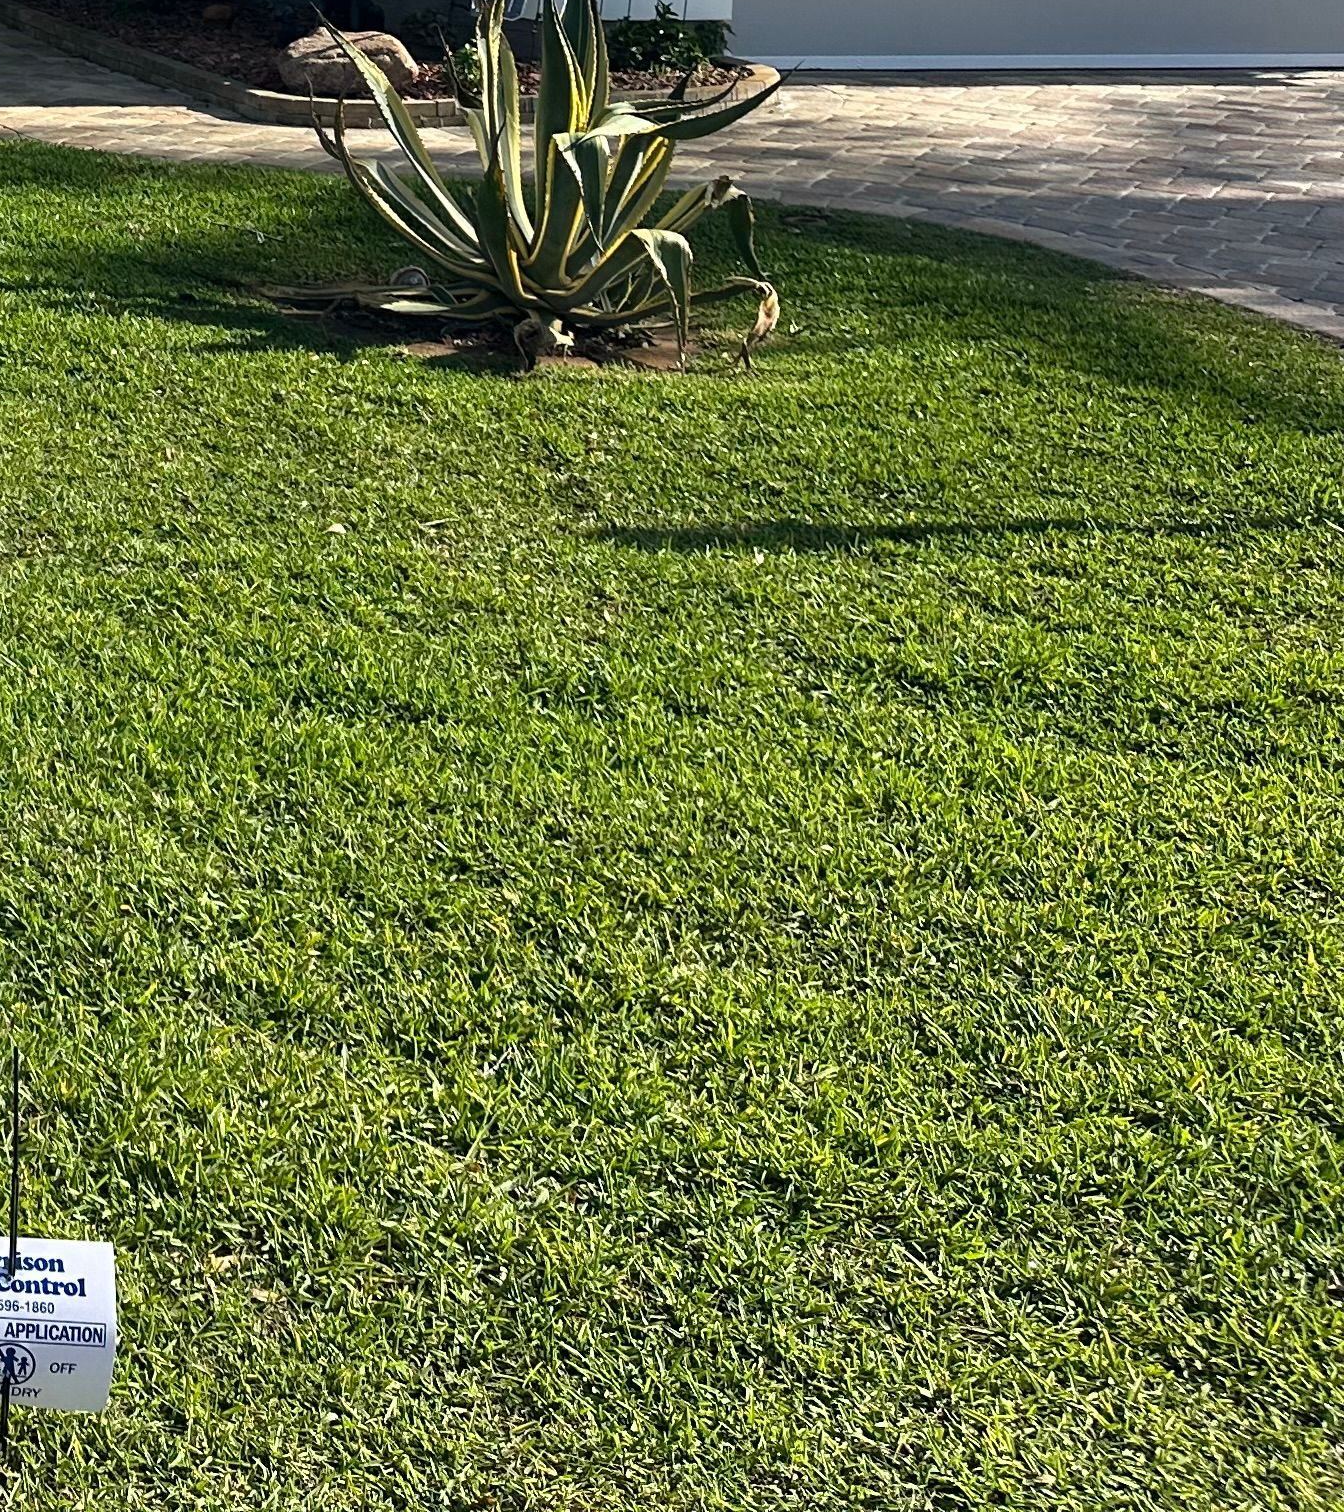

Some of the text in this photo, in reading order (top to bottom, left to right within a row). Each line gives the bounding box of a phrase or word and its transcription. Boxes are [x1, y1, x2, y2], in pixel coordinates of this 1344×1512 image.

[4, 1322, 104, 1344] APPLICATION
[49, 1362, 78, 1375] OFF
[11, 1386, 43, 1398] DRY
